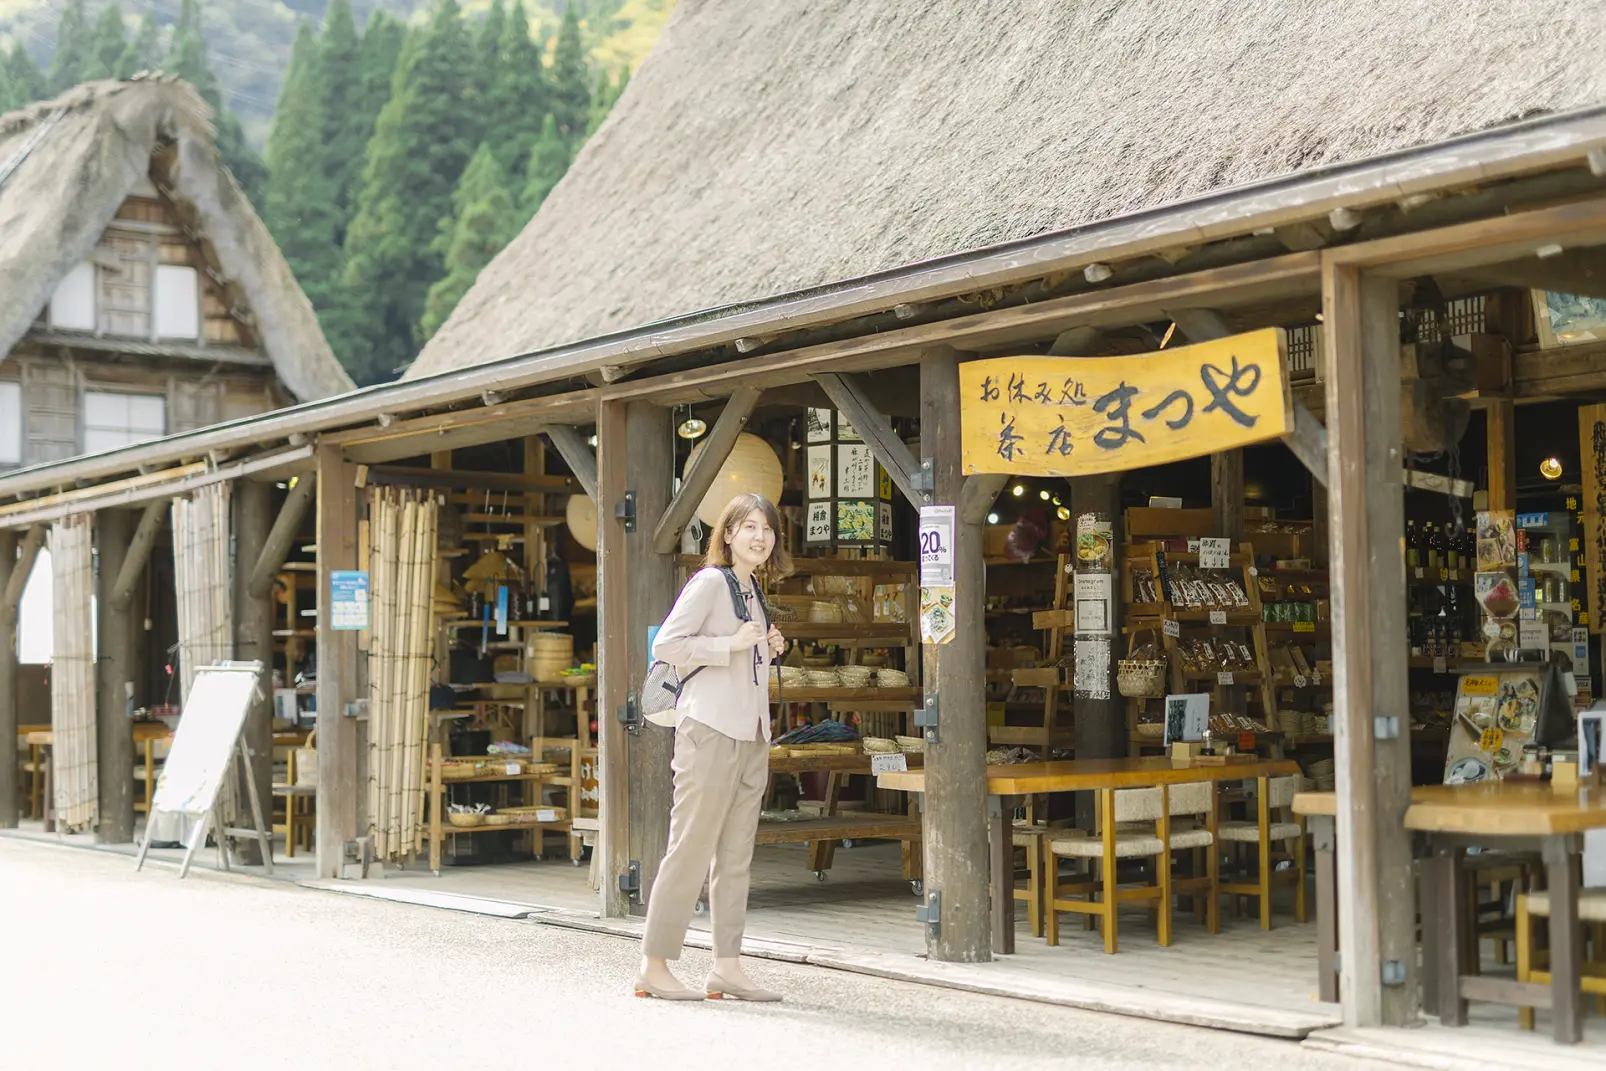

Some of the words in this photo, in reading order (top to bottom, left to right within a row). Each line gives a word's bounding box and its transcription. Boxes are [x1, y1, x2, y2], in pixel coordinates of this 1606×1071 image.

[1092, 354, 1262, 451] まつや
[996, 411, 1076, 463] 茶店
[809, 524, 830, 536] まつや
[921, 530, 947, 555] 20%
